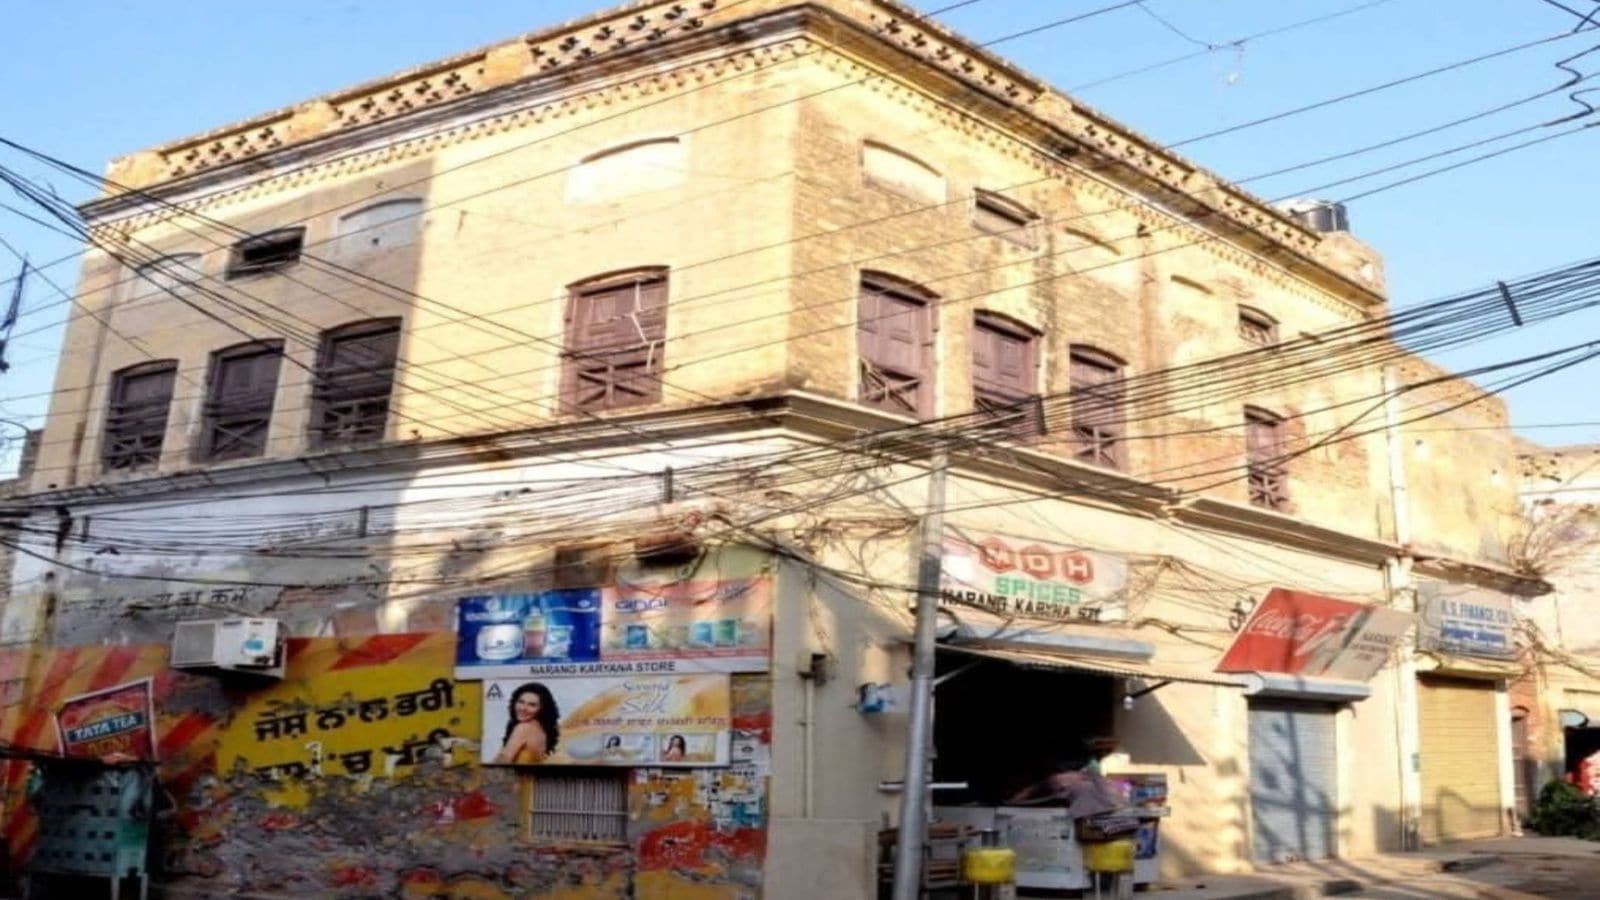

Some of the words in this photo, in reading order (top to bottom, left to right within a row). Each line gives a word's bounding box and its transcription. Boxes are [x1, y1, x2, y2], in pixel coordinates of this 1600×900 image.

[994, 577, 1081, 604] SPICES
[530, 665, 576, 674] NARANG
[580, 663, 633, 673] KARYANA
[636, 661, 675, 672] STORE
[74, 722, 111, 739] TATA
[112, 714, 138, 729] TEA
